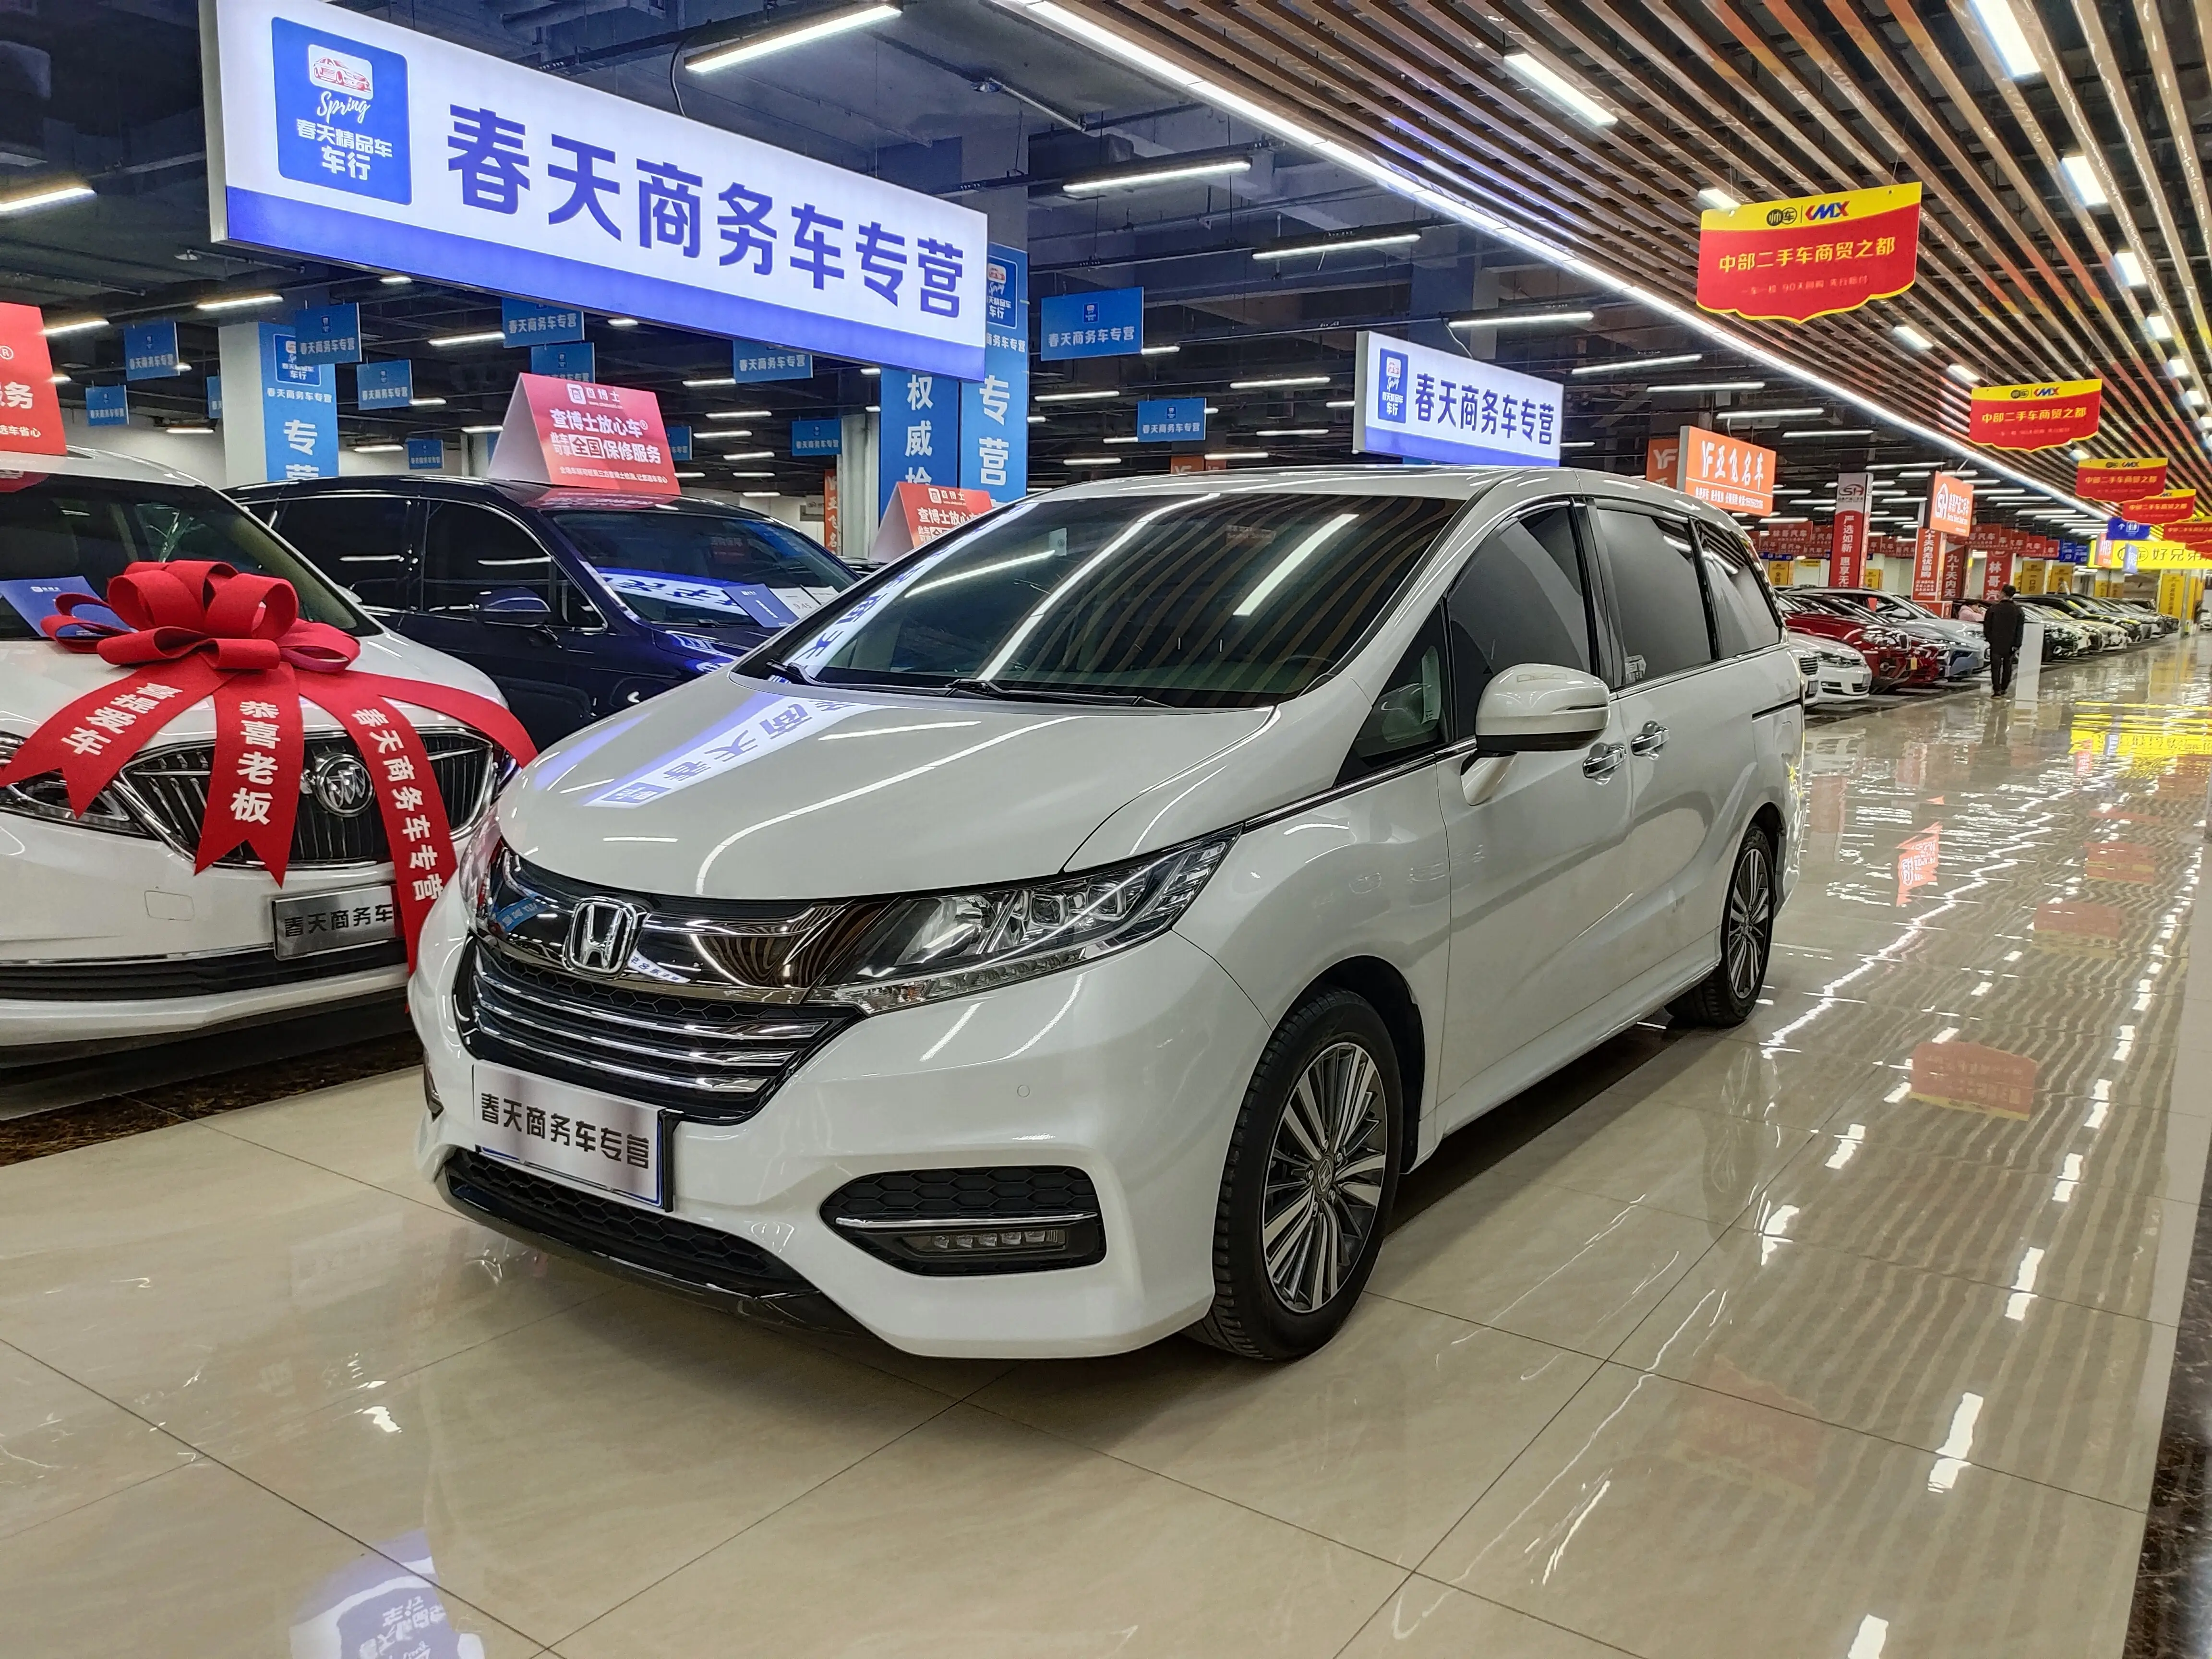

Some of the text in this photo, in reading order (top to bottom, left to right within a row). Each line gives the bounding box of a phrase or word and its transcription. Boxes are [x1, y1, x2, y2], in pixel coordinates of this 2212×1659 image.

[317, 91, 371, 123] Spring
[296, 119, 393, 157] 春天精品车
[321, 145, 371, 180] 车行
[447, 103, 963, 318] 春天商务车专营
[1719, 237, 1895, 272] 中部二手车商贸之都
[509, 313, 577, 334] 春天商务车专营
[989, 305, 1005, 319] 车行
[1048, 326, 1134, 347] 春天商务车专营
[739, 354, 805, 372] 春天商务车专营
[267, 388, 332, 403] 春天商务车专营
[1415, 373, 1554, 445] 春天商务车专营
[1982, 407, 2087, 423] 中部二手车商贸之都
[979, 374, 1010, 508] 专营
[61, 683, 183, 756] 喜提爱车
[230, 701, 281, 824] 恭喜老板
[352, 709, 444, 901] 春天商务车专营
[285, 904, 393, 938] 春天商务车
[481, 1093, 649, 1169] 春天商务车专营
